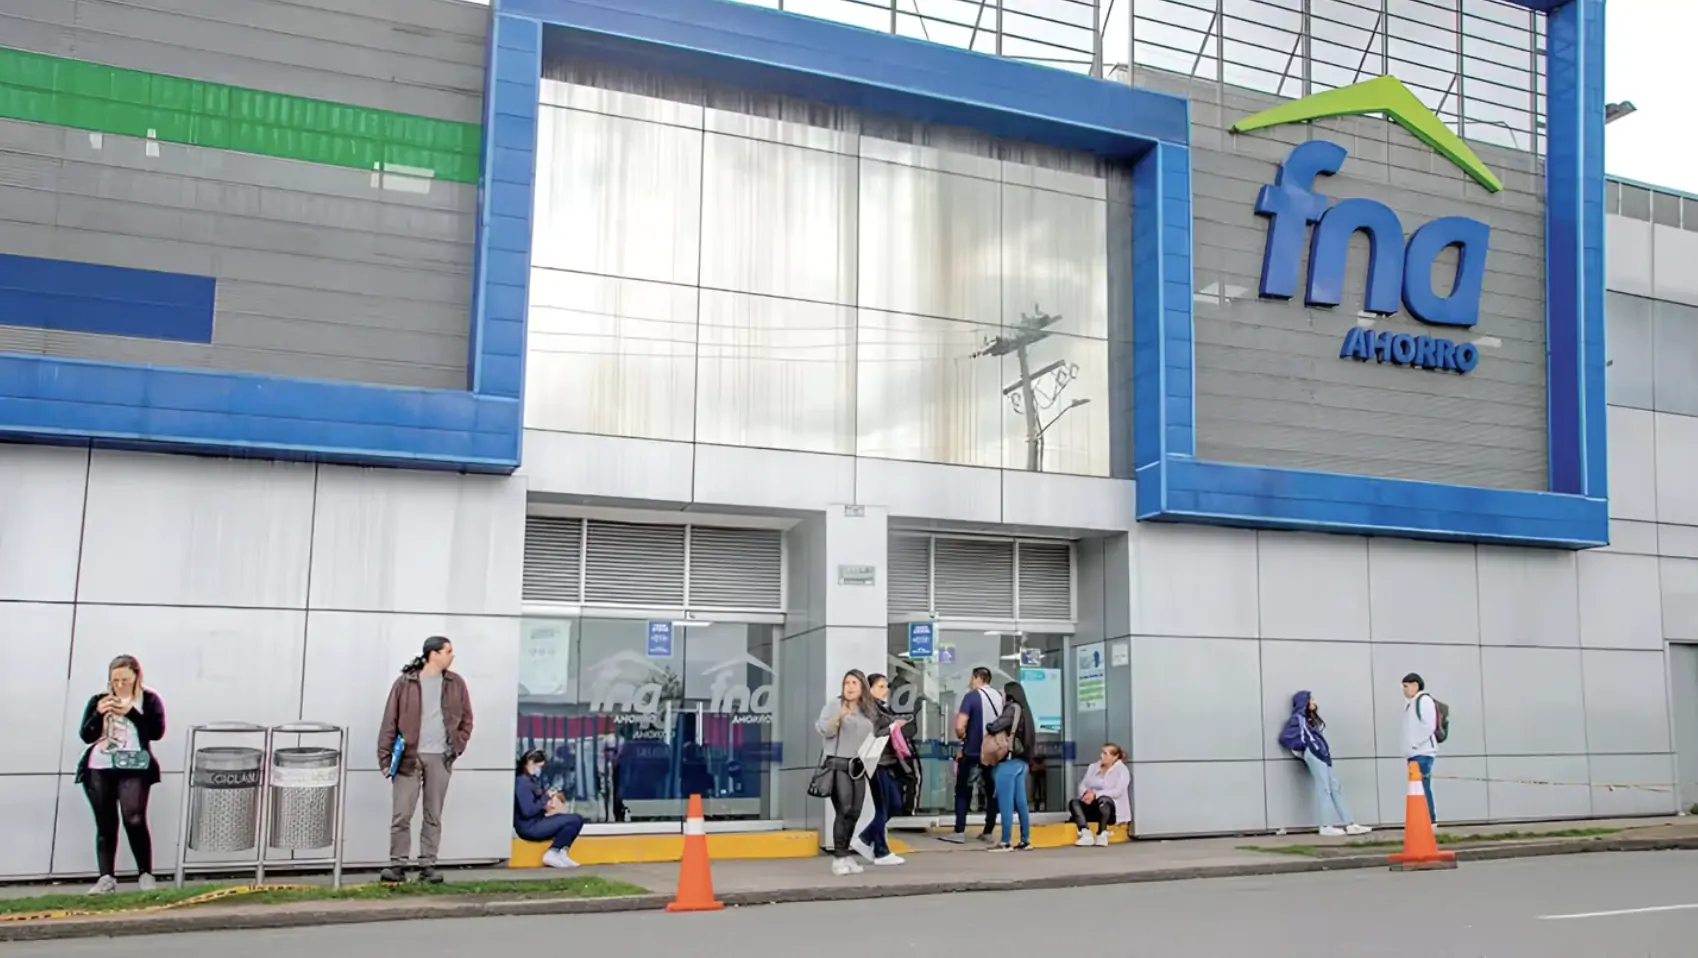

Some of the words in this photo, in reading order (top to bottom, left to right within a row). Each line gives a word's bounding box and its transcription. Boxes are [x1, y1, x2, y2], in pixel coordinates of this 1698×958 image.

[1254, 140, 1490, 327] fna
[1340, 326, 1479, 374] AHORRO
[708, 668, 775, 714] fna
